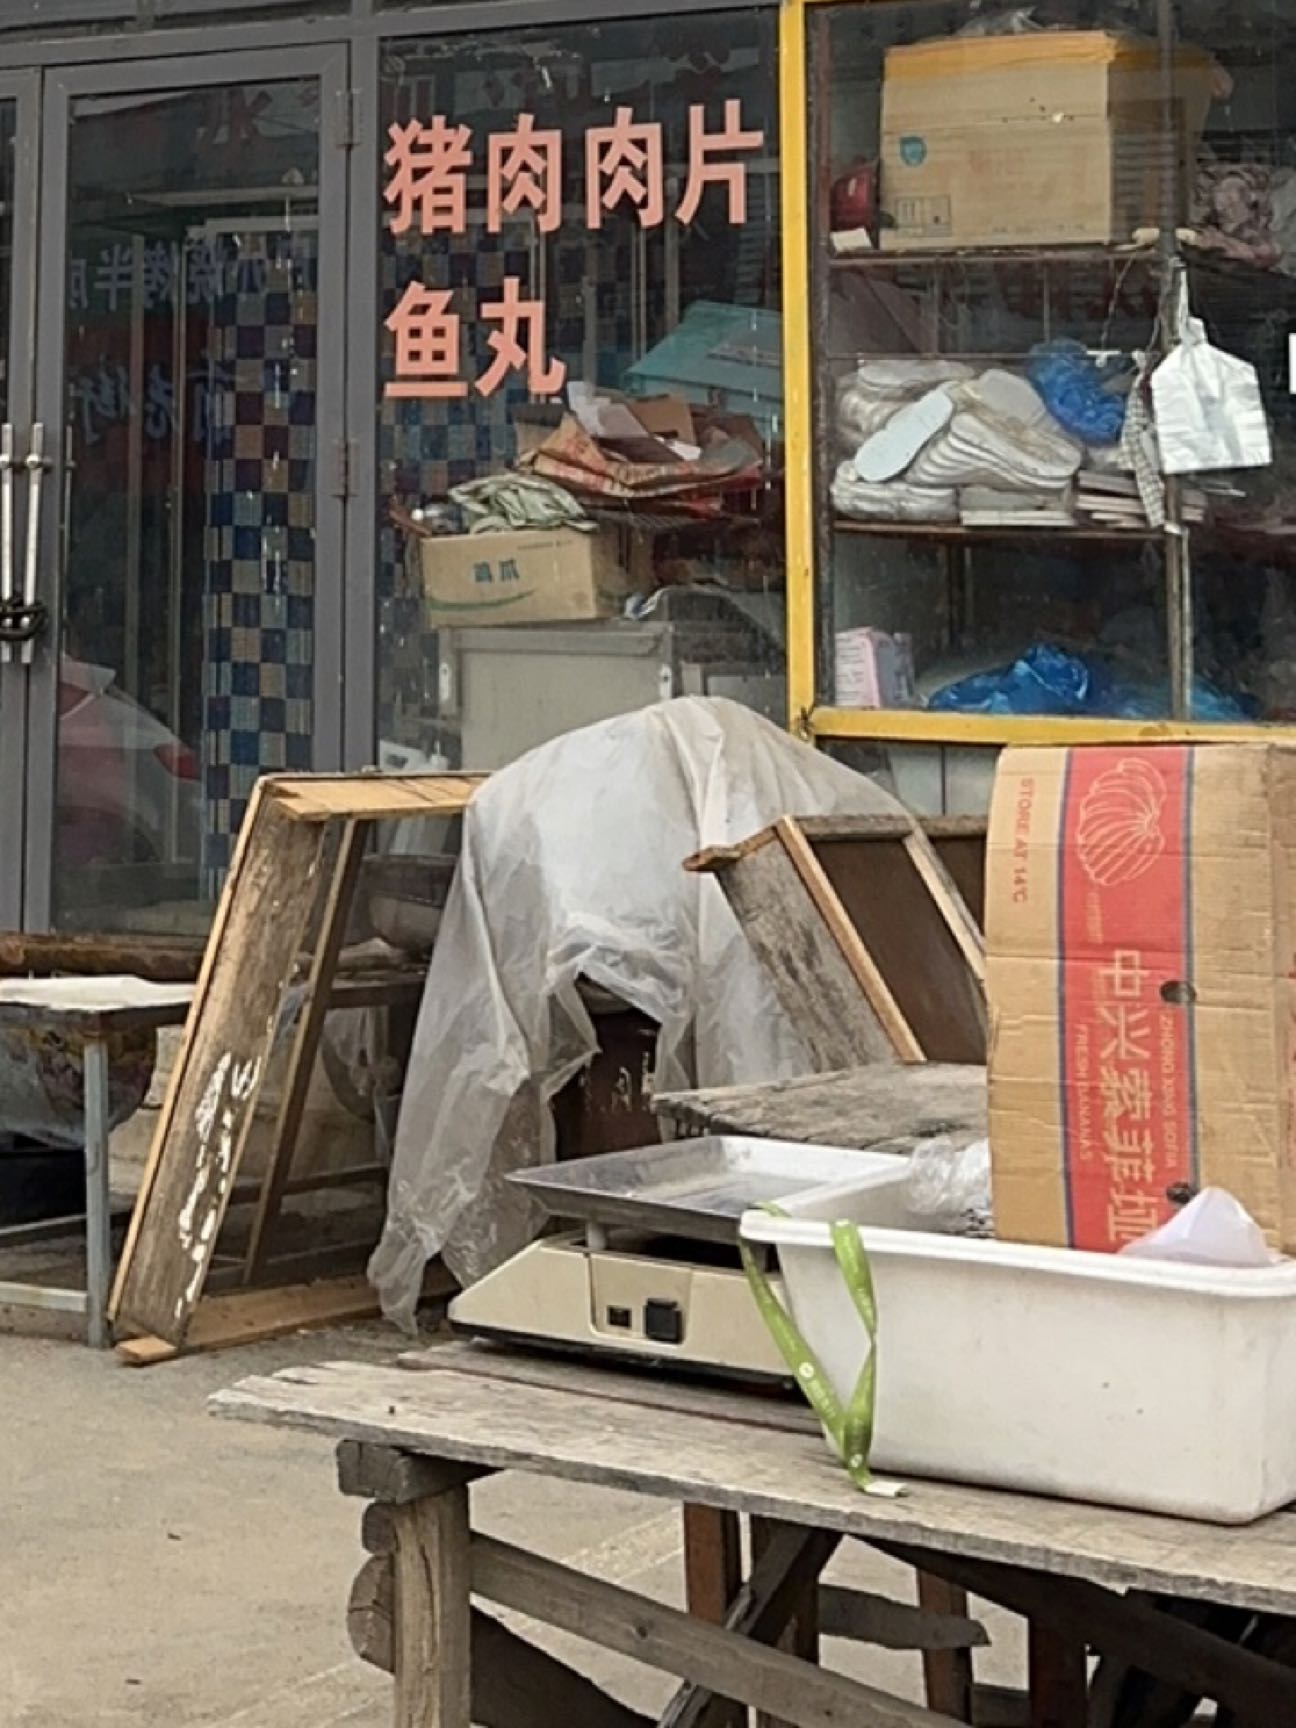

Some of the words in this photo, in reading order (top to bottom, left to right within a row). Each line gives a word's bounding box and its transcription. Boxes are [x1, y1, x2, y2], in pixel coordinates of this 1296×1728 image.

[383, 98, 765, 237] 猪肉肉片
[384, 275, 568, 398] 鱼丸
[1016, 777, 1036, 834] STORE
[1013, 836, 1028, 861] AT
[1075, 1024, 1090, 1078] FRESH
[1159, 1014, 1177, 1074] ZHONG
[1162, 1120, 1178, 1170] SOFIA
